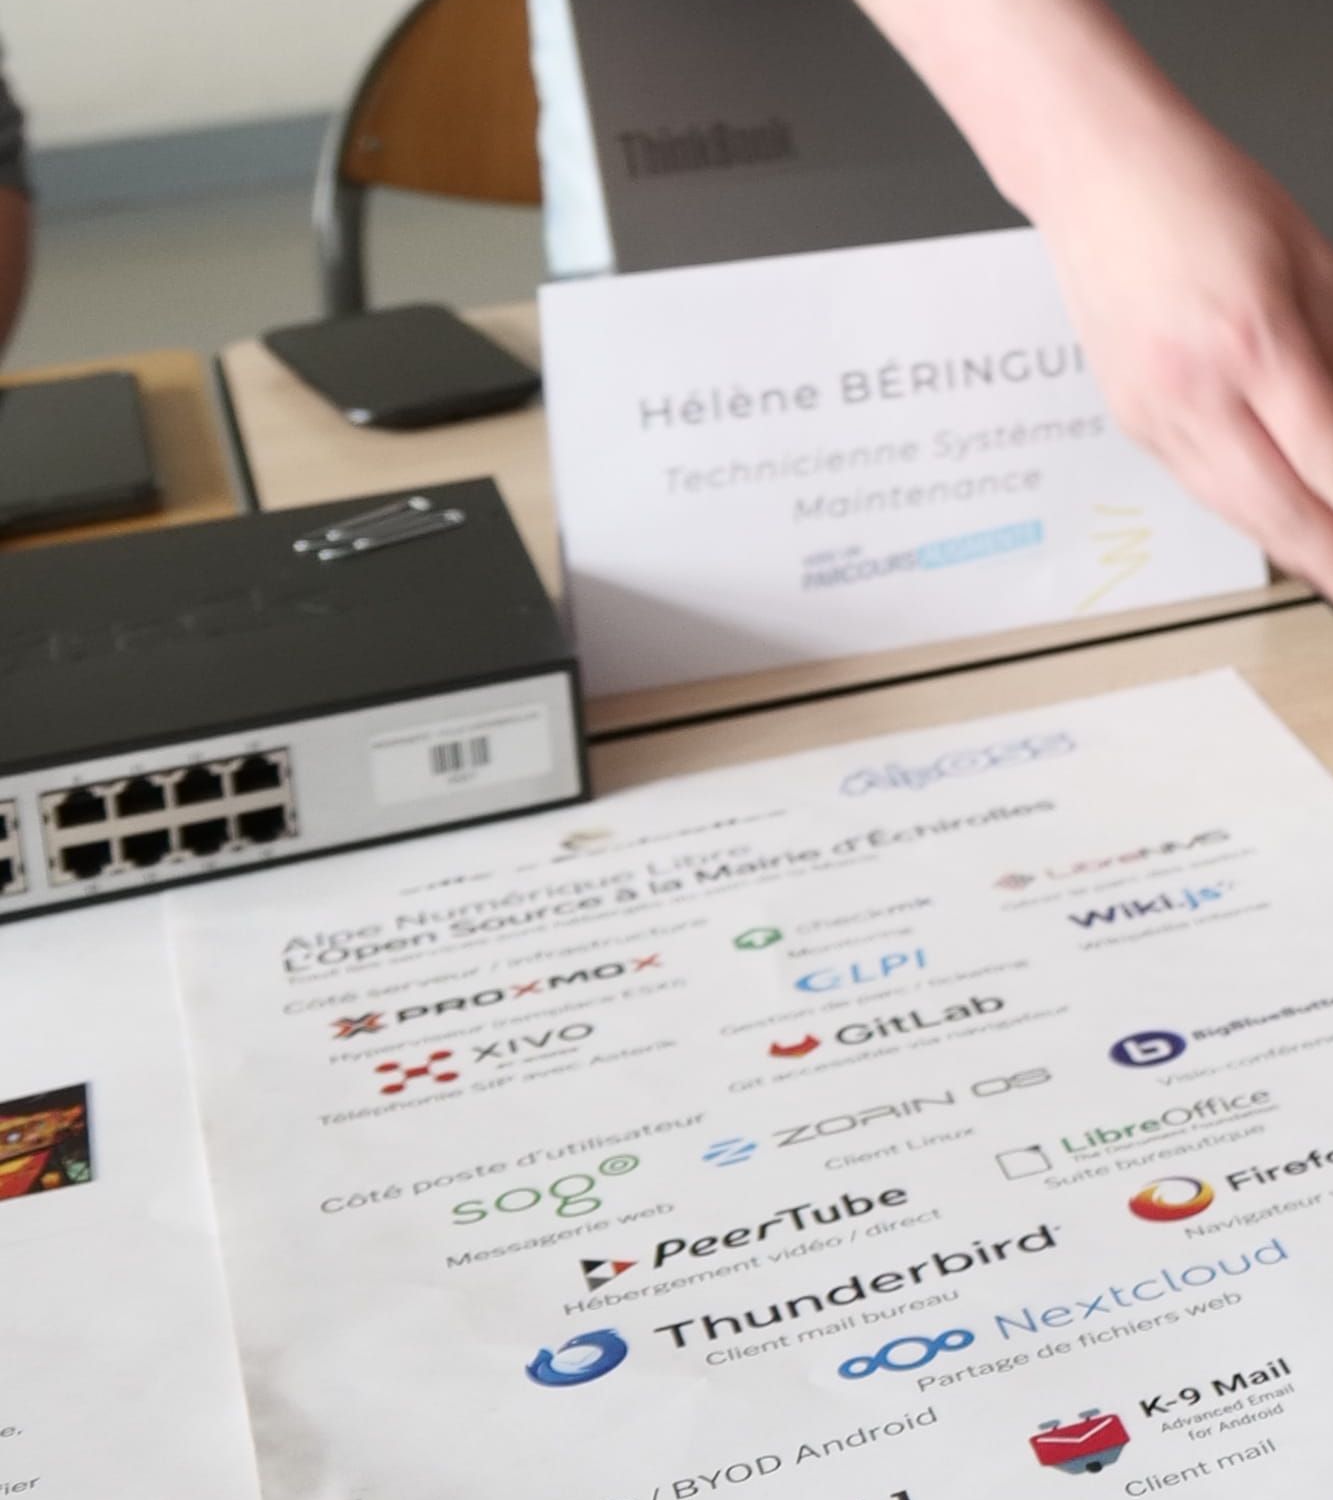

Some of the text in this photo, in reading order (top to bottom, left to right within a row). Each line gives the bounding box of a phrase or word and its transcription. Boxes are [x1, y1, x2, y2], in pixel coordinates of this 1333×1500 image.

[639, 377, 821, 431] Hélène
[664, 414, 1106, 497] Technicienne Systèmes
[792, 469, 1042, 525] Maintenance
[284, 923, 383, 953] Alpe
[396, 870, 635, 930] Numérique
[648, 846, 752, 876] Libre
[449, 896, 603, 937] Source
[616, 887, 638, 903] à
[649, 878, 683, 894] la
[695, 849, 821, 883] Mairie
[506, 917, 708, 970] infrastructure
[793, 947, 928, 993] GLPI
[396, 953, 664, 1022] PROXMOX
[834, 995, 1006, 1046] GitLab
[473, 1022, 595, 1062] XIVO
[320, 1087, 465, 1126] Téléphonie
[771, 1066, 1053, 1148] ZORIN OS
[1060, 1088, 1271, 1154] LibreOffice
[824, 1125, 976, 1171] Client Linux
[1043, 1122, 1268, 1189] Suite bureautique
[320, 1183, 404, 1214] Côté
[411, 1161, 509, 1196] poste
[1183, 1193, 1324, 1241] Navigateur
[445, 1201, 675, 1269] Messagerie web
[653, 1187, 909, 1270] PeerTube
[563, 1256, 761, 1316] Hébergement
[767, 1235, 843, 1263] vidéo
[865, 1208, 942, 1238] direct
[653, 1224, 1058, 1349] Thunderbird
[994, 1238, 1289, 1340] Nextcloud
[705, 1288, 961, 1366] Client mail bureau
[916, 1290, 1243, 1393] Partage de fichiers web
[1139, 1357, 1292, 1419] K-9 Mail
[1161, 1383, 1295, 1433] Advanced Email
[671, 1454, 782, 1500] BYOD
[795, 1406, 939, 1464] Android
[1187, 1403, 1285, 1441] for Android
[1124, 1438, 1277, 1497] Client mail
